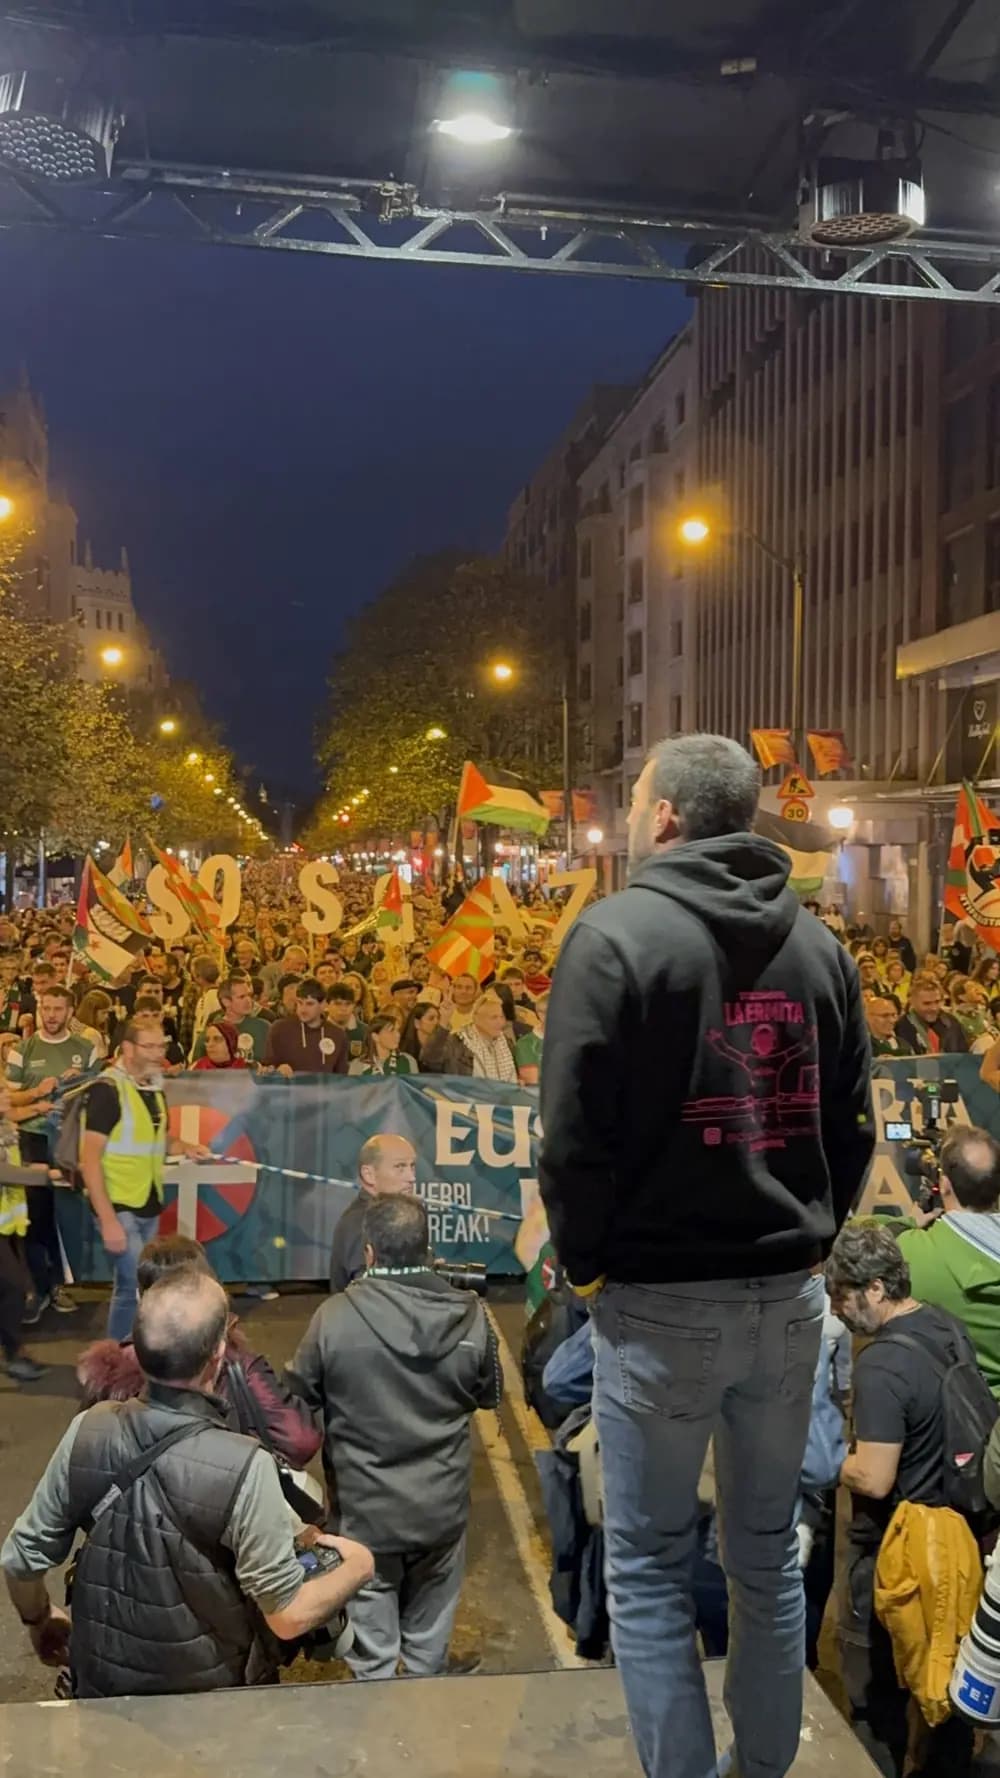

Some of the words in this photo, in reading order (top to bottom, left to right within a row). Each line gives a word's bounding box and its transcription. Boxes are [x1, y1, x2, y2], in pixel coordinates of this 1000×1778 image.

[787, 808, 805, 819] 30
[434, 1099, 544, 1168] EU
[427, 1213, 491, 1244] REAK!
